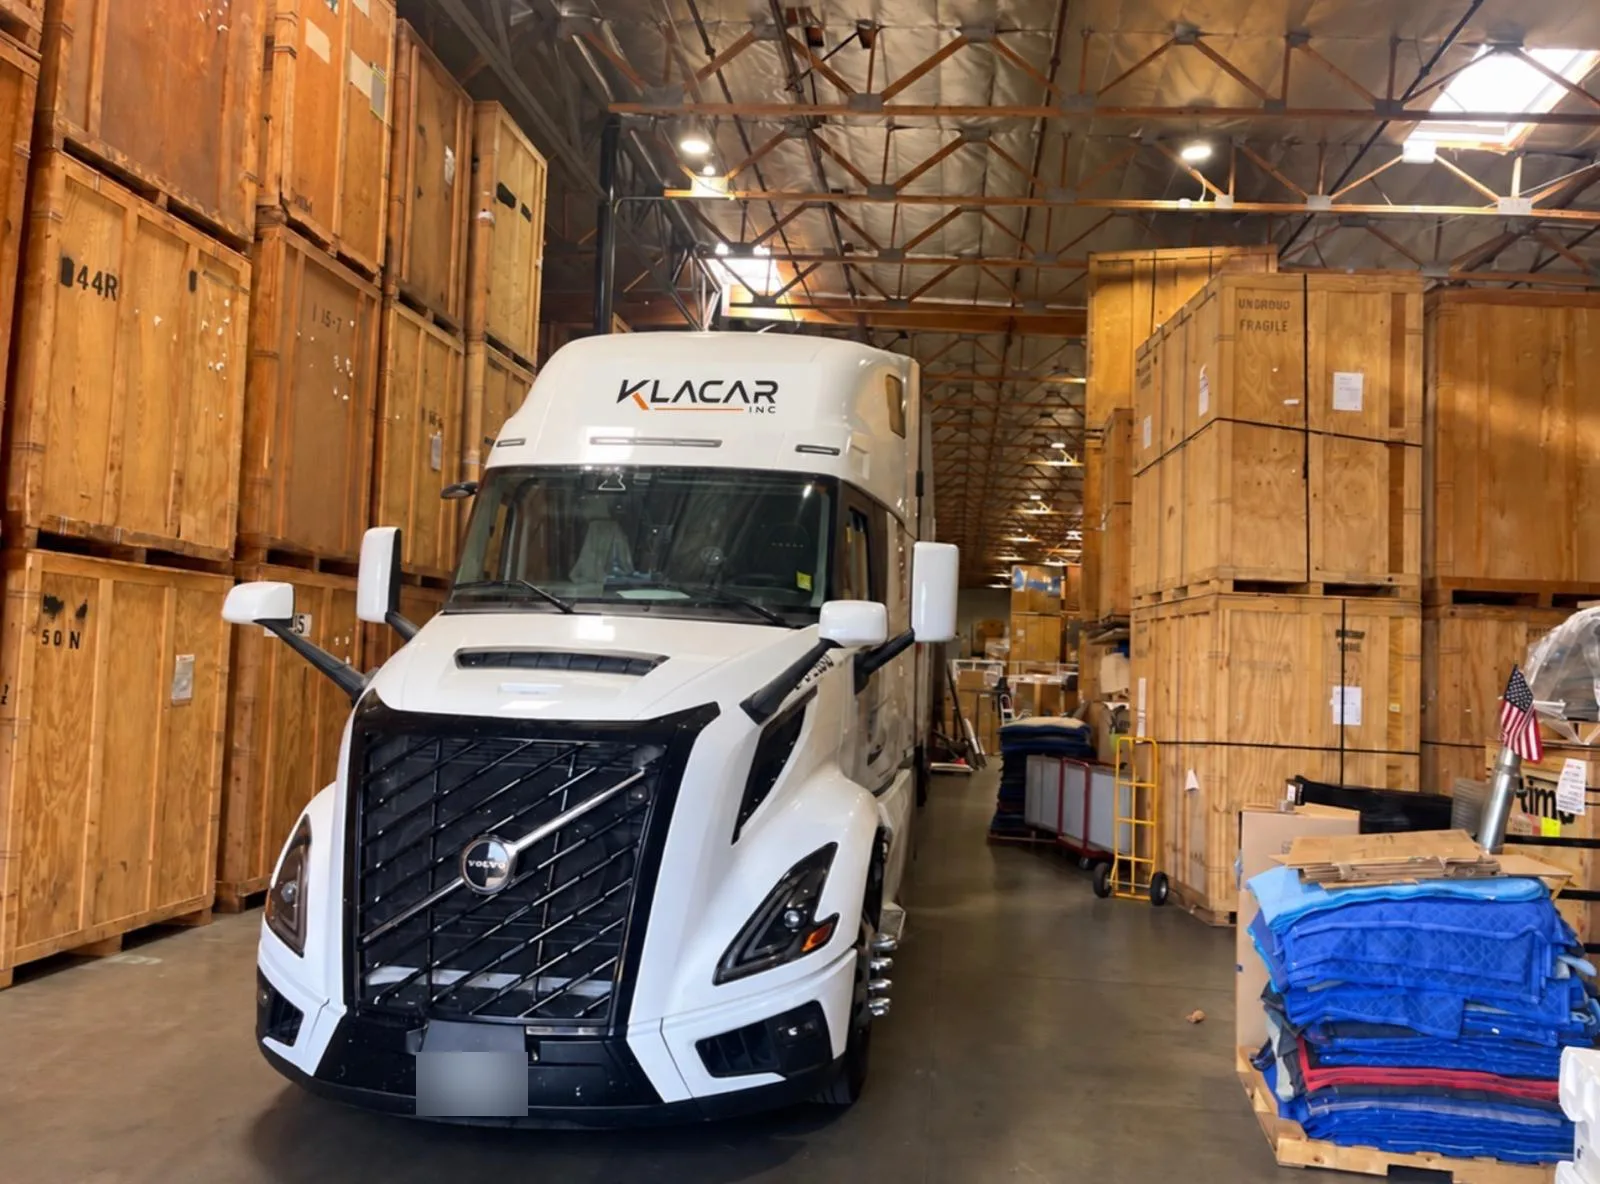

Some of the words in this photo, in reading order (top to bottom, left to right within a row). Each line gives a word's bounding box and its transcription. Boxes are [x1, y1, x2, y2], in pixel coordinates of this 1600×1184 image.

[1240, 319, 1287, 332] FRAGILE
[616, 379, 779, 410] KLACAR
[468, 860, 506, 869] VOLVO
